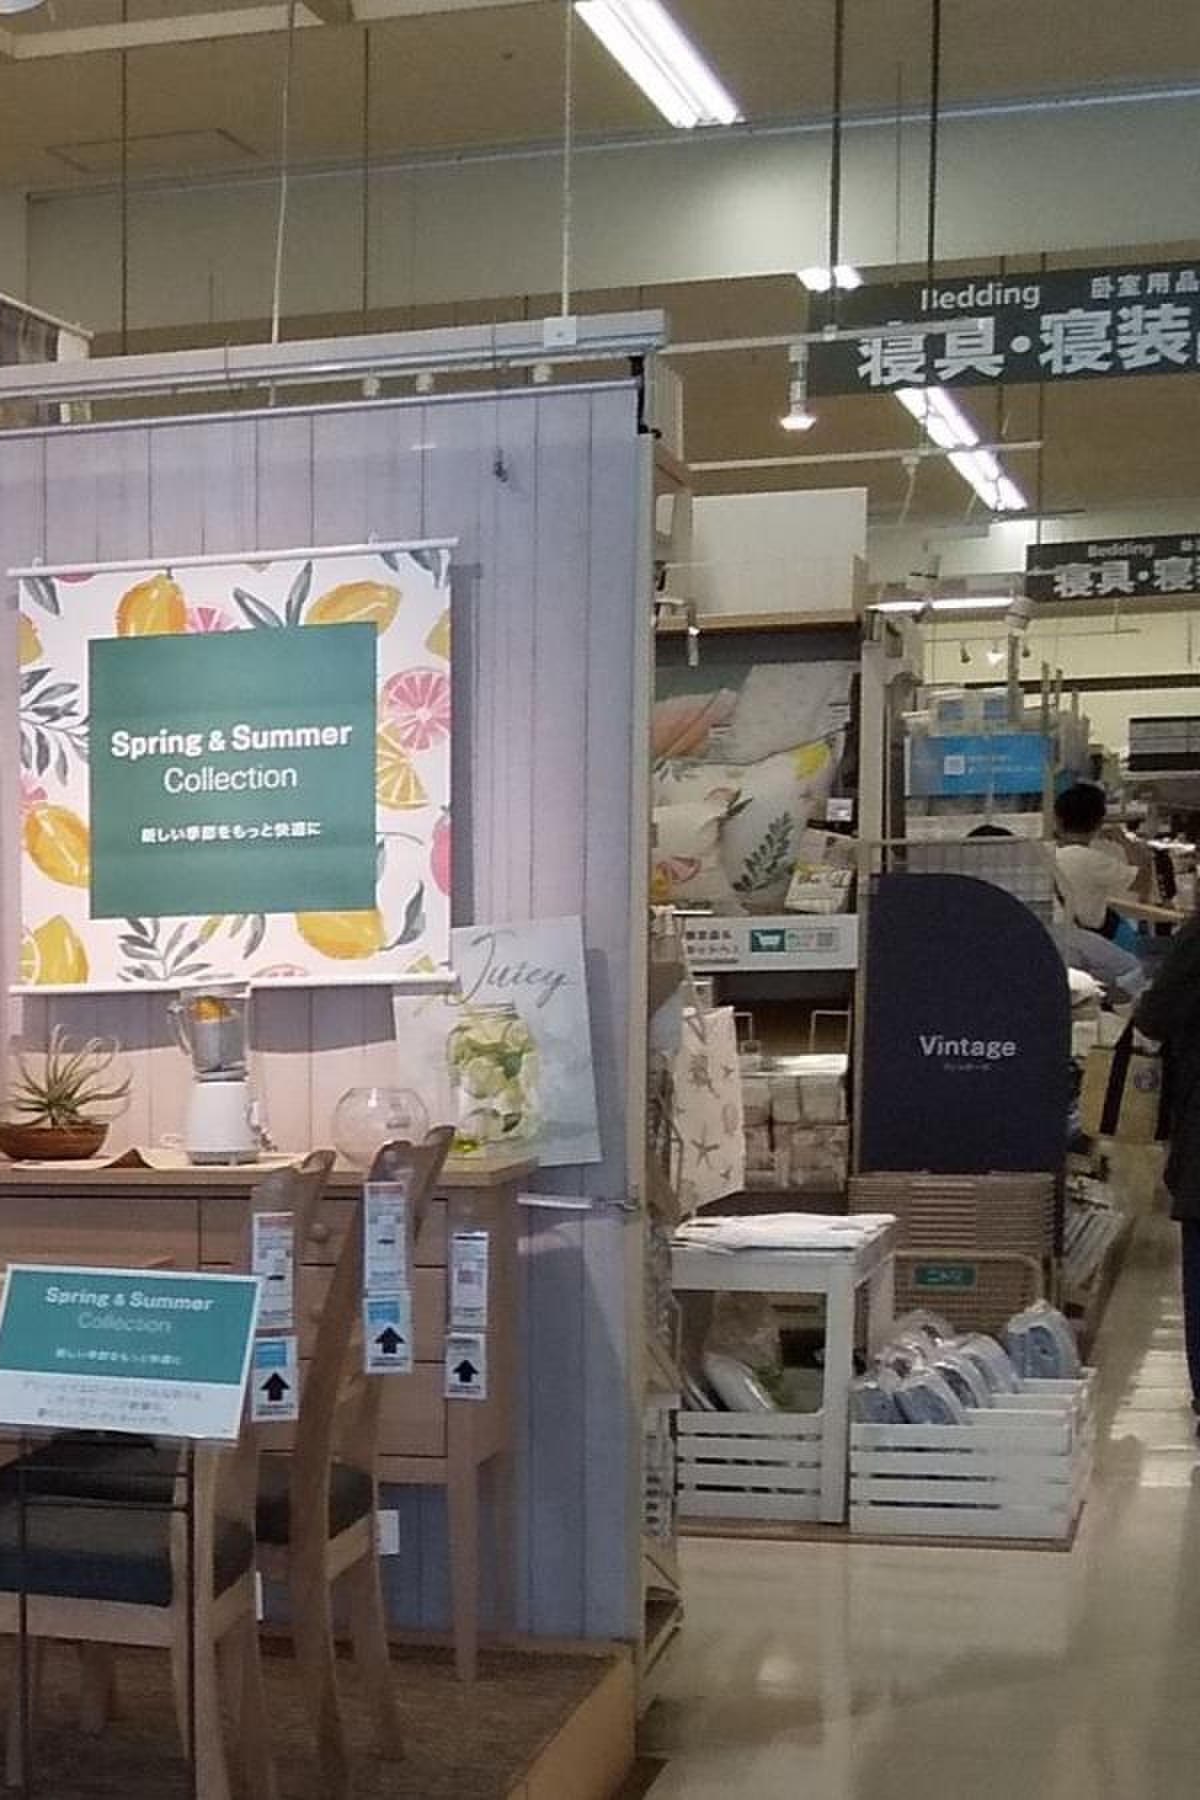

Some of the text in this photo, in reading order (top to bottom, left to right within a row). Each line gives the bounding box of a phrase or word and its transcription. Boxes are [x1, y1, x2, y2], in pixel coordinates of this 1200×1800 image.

[857, 303, 1200, 386] 寝具・寝装
[1053, 556, 1200, 598] 寝具・寝
[111, 724, 353, 760] Spring & Summer
[163, 766, 298, 793] Collection
[446, 932, 568, 1008] Juicy
[919, 1034, 1017, 1059] Vintage
[46, 1286, 110, 1308] Spring
[129, 1291, 214, 1310] Summer
